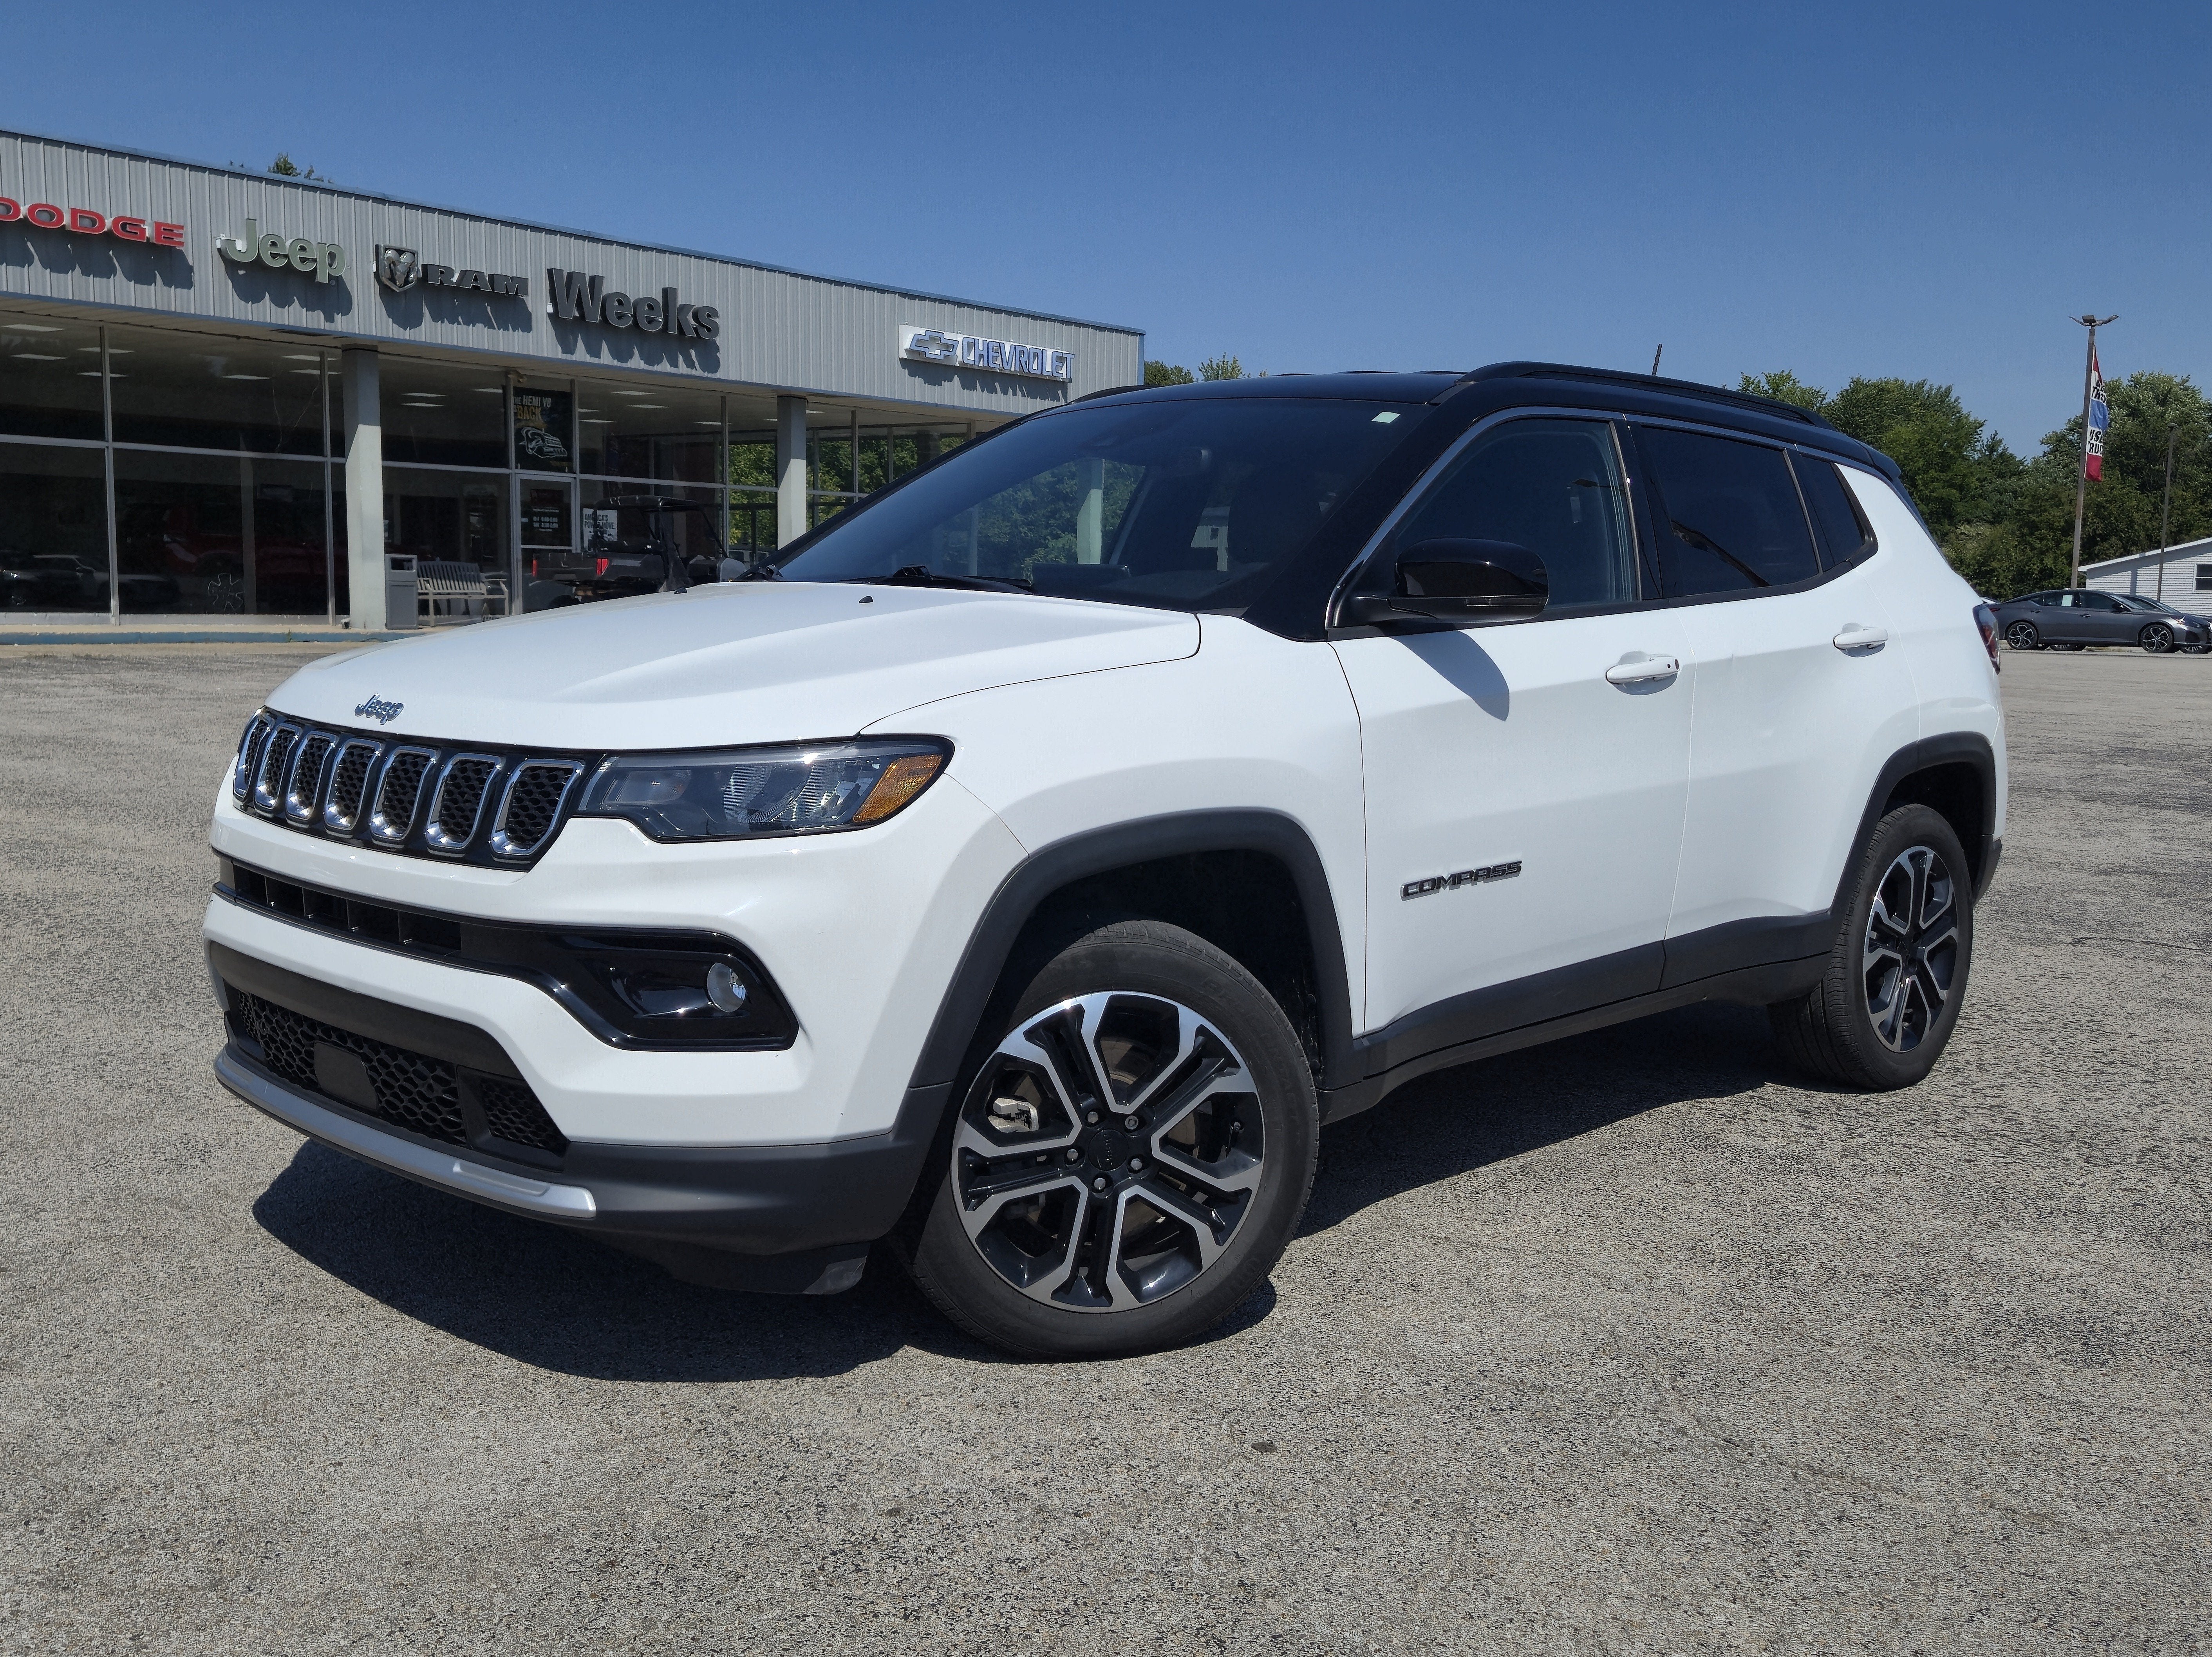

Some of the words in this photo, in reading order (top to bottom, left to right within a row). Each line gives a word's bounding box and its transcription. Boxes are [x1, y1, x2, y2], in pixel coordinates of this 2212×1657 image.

[0, 197, 184, 247] DODGE
[216, 218, 346, 283] Jeep
[421, 264, 529, 296] RAM
[547, 268, 720, 339] Weeks
[962, 337, 1075, 379] CHEVROLET
[517, 405, 544, 422] BACK
[523, 395, 540, 407] HEMI
[354, 693, 405, 725] Jeep
[1401, 861, 1522, 901] COMPASS
